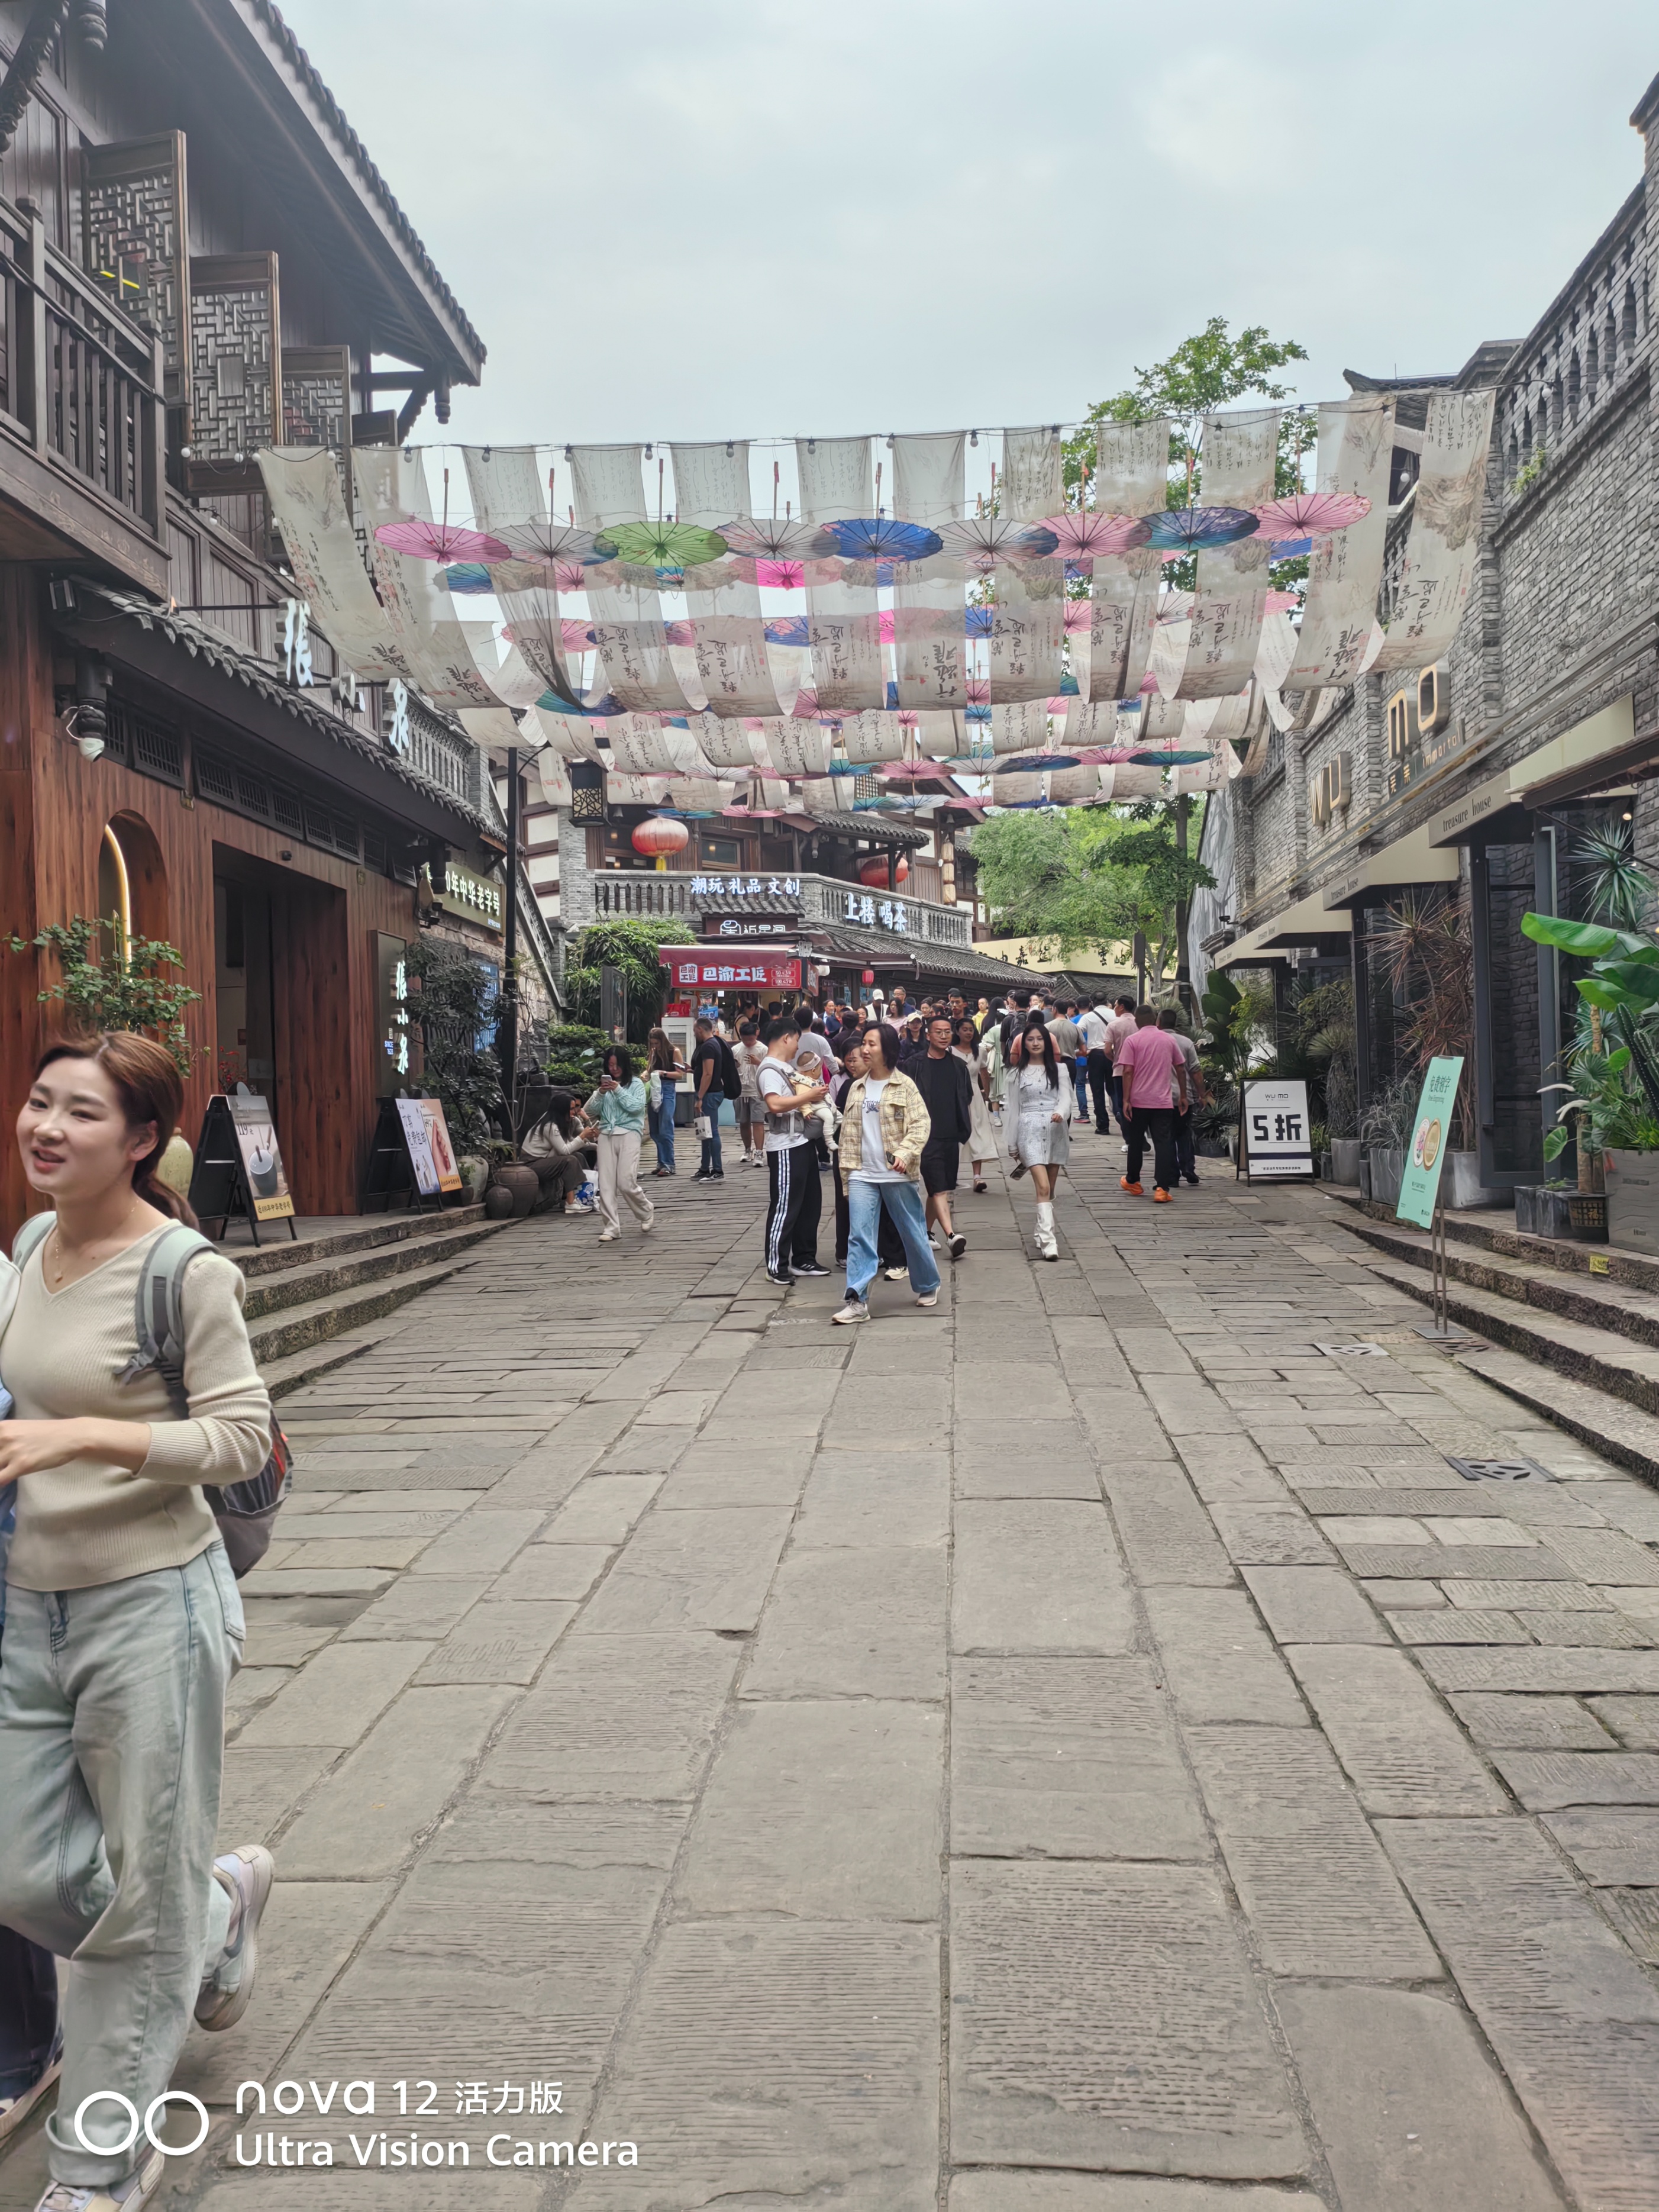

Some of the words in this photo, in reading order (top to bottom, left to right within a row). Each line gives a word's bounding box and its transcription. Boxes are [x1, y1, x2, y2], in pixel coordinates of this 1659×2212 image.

[1422, 726, 1461, 769] immortal
[1442, 809, 1468, 833] treasure
[1471, 795, 1492, 817] house
[690, 876, 724, 894] 潮玩
[728, 877, 761, 895] 礼品
[767, 878, 800, 896] 文创
[845, 892, 875, 924] 上楼
[879, 901, 908, 933] 喝茶
[703, 967, 767, 982] 巴渝工匠
[1253, 1114, 1302, 1141] 5折
